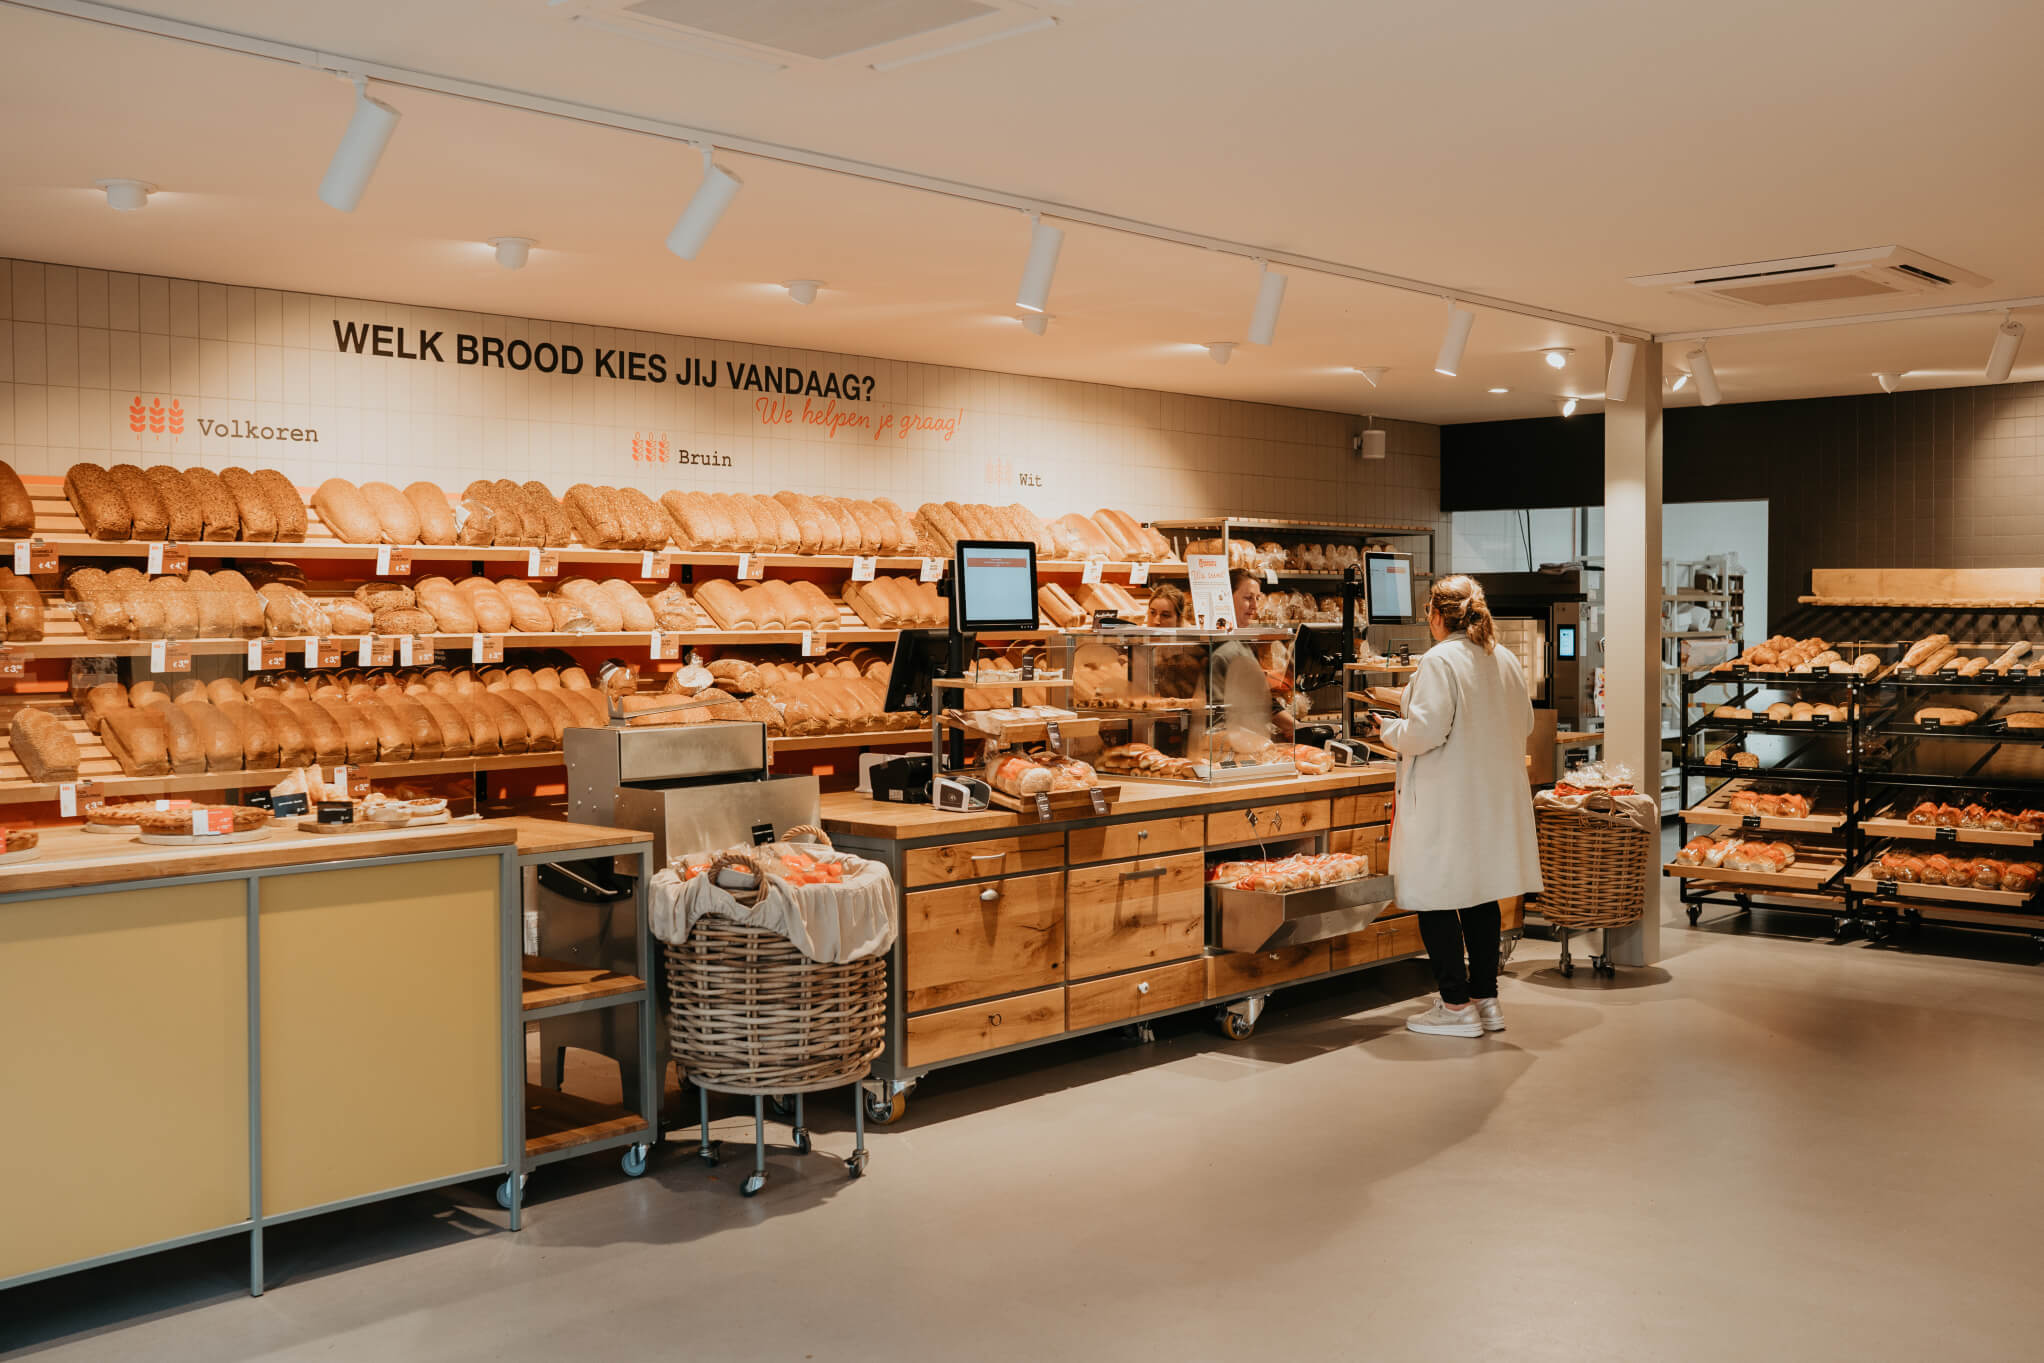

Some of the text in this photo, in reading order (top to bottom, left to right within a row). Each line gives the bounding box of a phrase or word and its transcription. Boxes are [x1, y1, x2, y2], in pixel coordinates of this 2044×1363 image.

[333, 320, 876, 402] WELK BROOD KIES JIJ VANDAAG?
[197, 418, 319, 442] Volkoren
[755, 396, 965, 441] We helpen je graag!
[678, 449, 733, 467] Bruin
[1019, 472, 1043, 488] Wit
